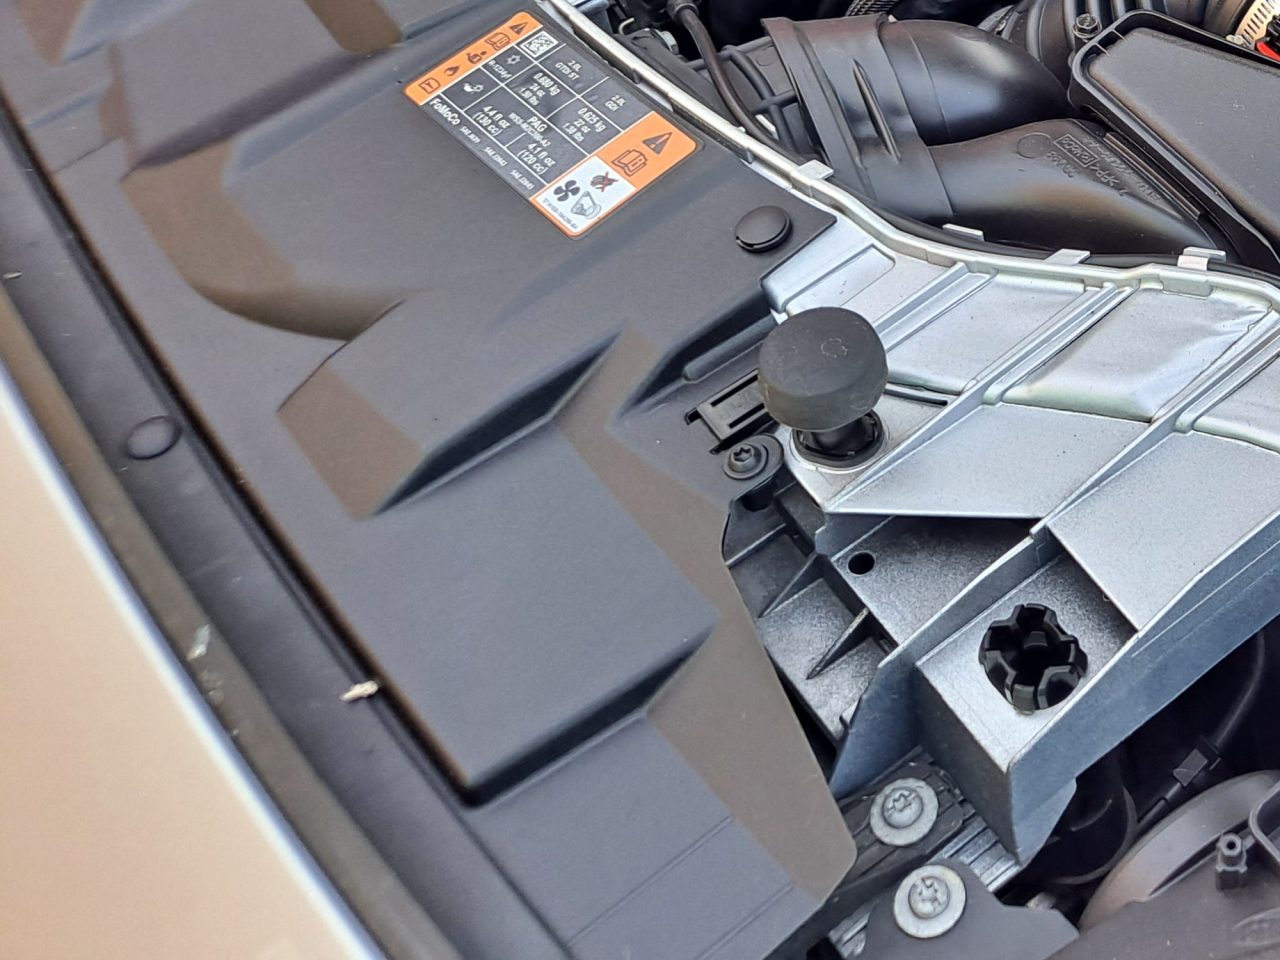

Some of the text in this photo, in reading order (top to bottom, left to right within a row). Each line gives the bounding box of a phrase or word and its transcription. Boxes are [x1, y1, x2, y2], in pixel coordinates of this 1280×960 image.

[568, 71, 580, 80] ST
[536, 89, 546, 97] oz
[548, 84, 561, 96] kg
[528, 95, 539, 106] lbs
[429, 98, 461, 125] FoMoCo
[483, 106, 511, 129] 4.4 fl oz
[472, 111, 503, 137] (130 cc)
[526, 116, 547, 132] PAG
[577, 107, 607, 132] 0.625 kg
[460, 126, 472, 136] SAE
[580, 123, 591, 133] oz
[572, 131, 584, 142] lbs
[484, 147, 496, 156] SAE
[528, 143, 556, 167] 4.1 fl oz
[1062, 138, 1092, 164] FoMoCo
[516, 149, 549, 175] (120 cc)
[510, 170, 522, 179] SAE
